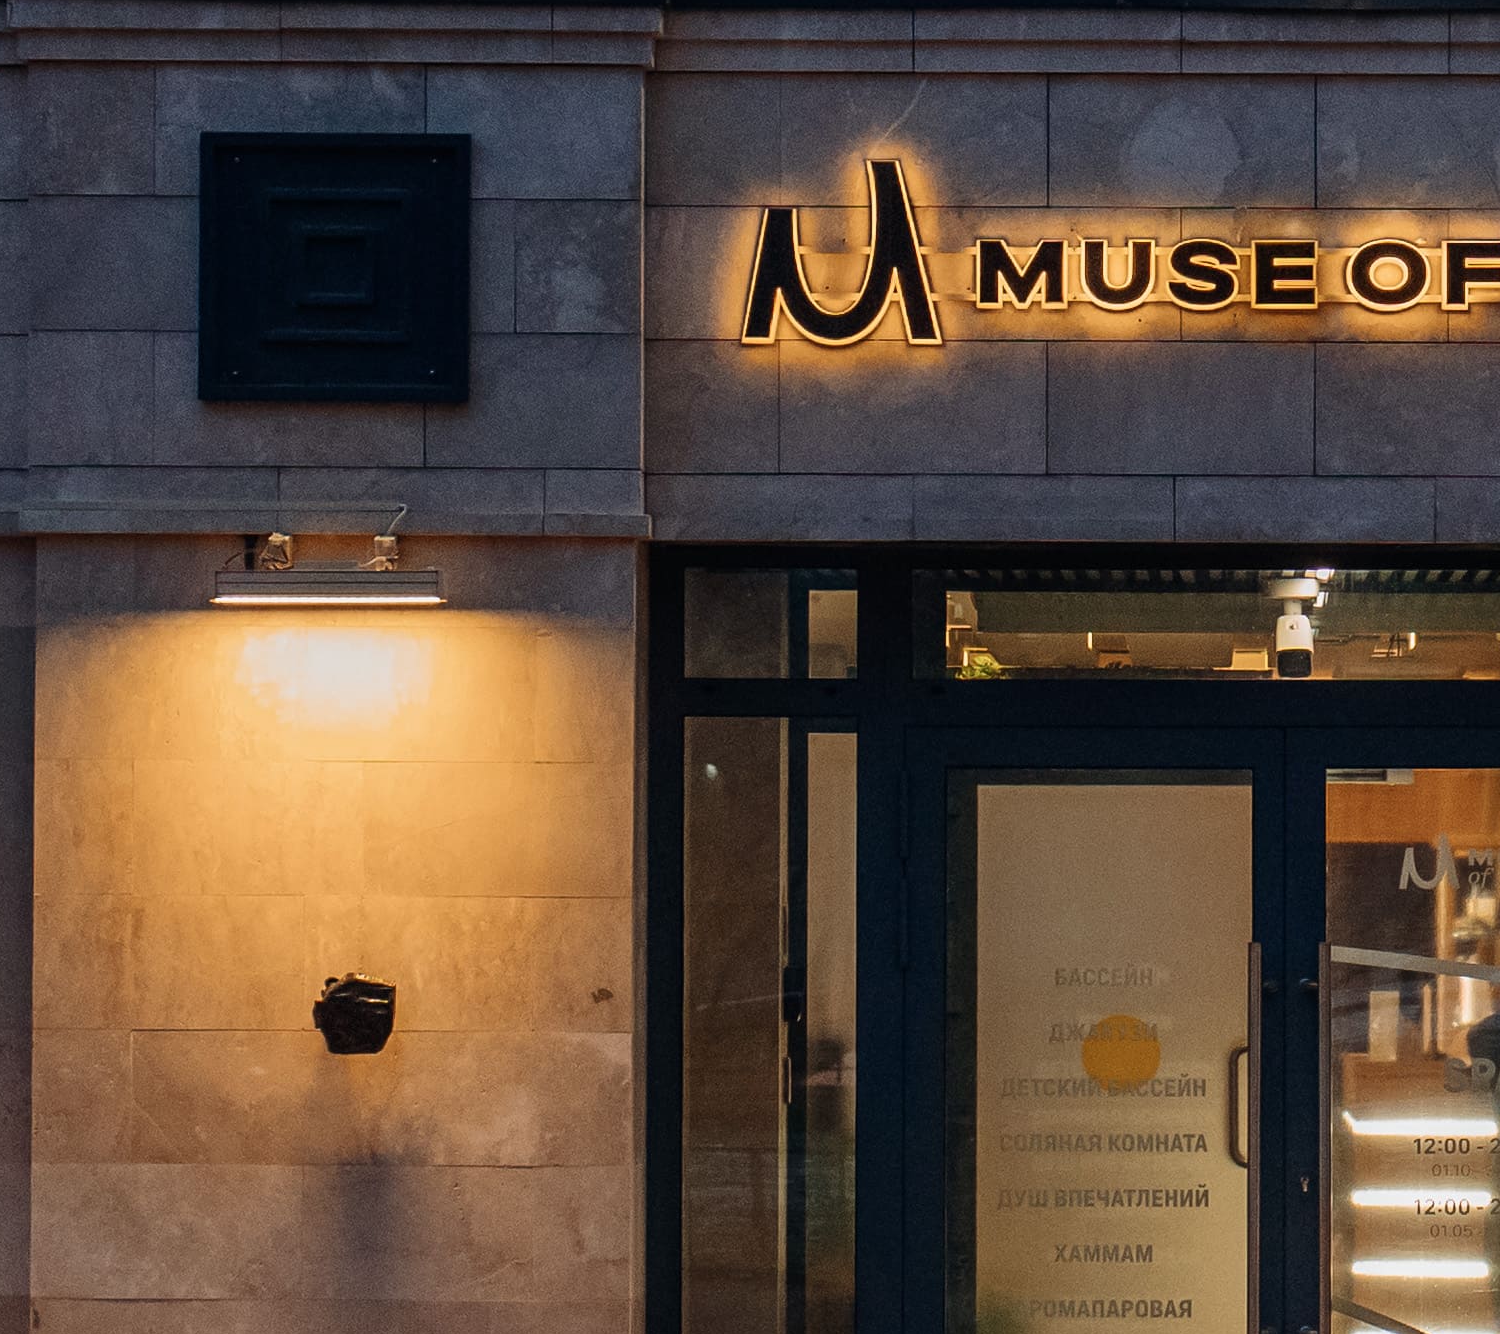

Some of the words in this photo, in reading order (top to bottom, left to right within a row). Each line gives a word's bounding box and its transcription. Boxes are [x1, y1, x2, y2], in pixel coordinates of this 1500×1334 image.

[973, 237, 1320, 313] MUSE
[1467, 867, 1495, 889] of
[1054, 963, 1154, 987] БАССЕЙН
[1107, 1073, 1207, 1098] БАССЕЙН
[1000, 1133, 1102, 1153] СОЛЯНАЯ
[1107, 1133, 1208, 1153] КОМНАТА
[1413, 1138, 1471, 1155] 12:00
[1054, 1184, 1210, 1208] ВПЕЧАТЛЕНИЙ
[1414, 1198, 1471, 1216] 12:00
[1054, 1243, 1154, 1264] ХАММАМ
[1017, 1298, 1193, 1319] РОМАПАРОВАЯ
